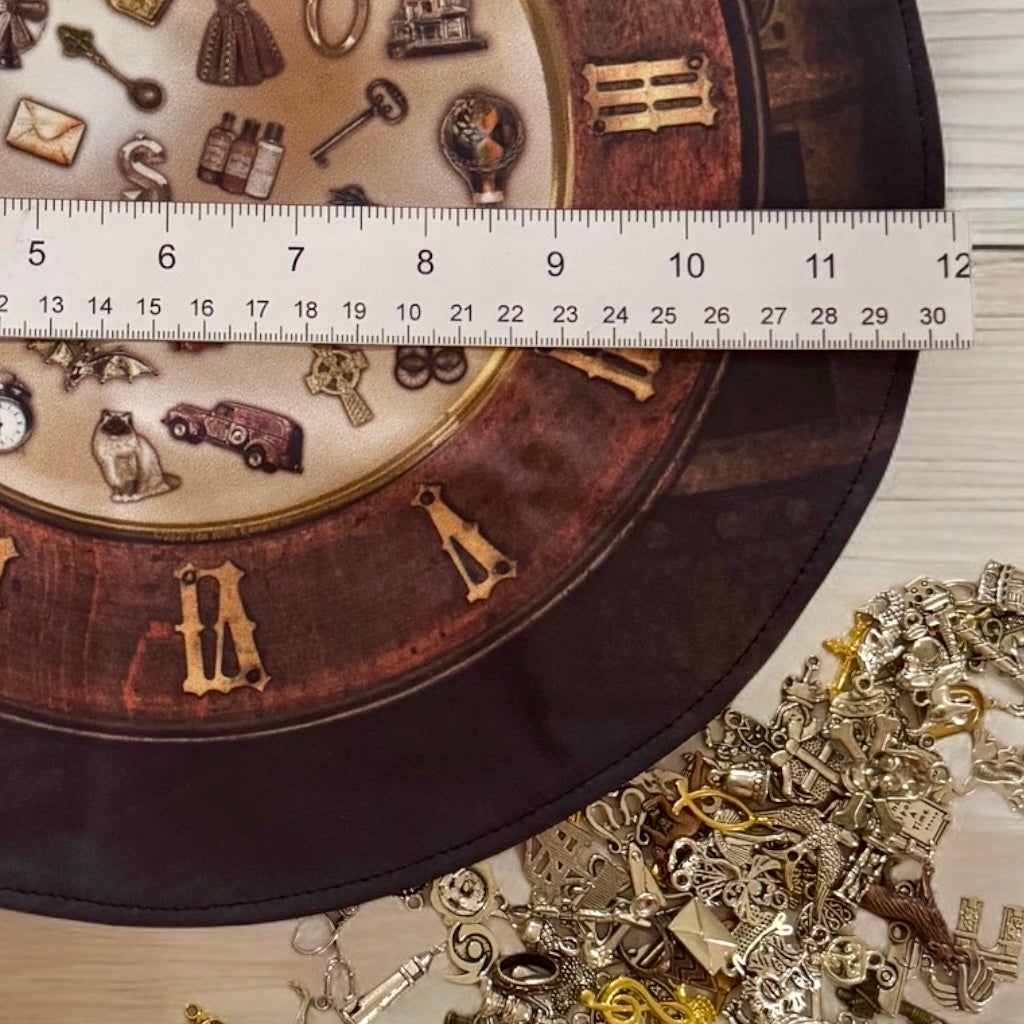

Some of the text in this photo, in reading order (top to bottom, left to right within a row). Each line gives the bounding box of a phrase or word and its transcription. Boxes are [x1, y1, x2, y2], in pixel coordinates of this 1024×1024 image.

[28, 240, 46, 267] 5
[158, 243, 176, 270] 6
[287, 246, 305, 272] 7
[416, 249, 435, 276] 8
[546, 250, 565, 278] 9
[669, 251, 705, 279] 10
[805, 252, 835, 279] 11
[936, 252, 971, 279] 12
[39, 295, 64, 314] 13
[88, 296, 113, 315] 14
[137, 297, 162, 316] 15
[190, 298, 214, 317] 16
[246, 299, 270, 318] 17
[294, 300, 318, 319] 18
[342, 301, 367, 320] 19
[396, 303, 422, 321] 10
[450, 303, 472, 322] 21
[497, 304, 524, 323] 22
[552, 305, 579, 323] 23
[602, 305, 629, 324] 24
[650, 305, 677, 325] 25
[703, 305, 731, 325] 26
[760, 306, 788, 325] 27
[810, 306, 838, 326] 28
[861, 306, 889, 326] 29
[919, 306, 947, 326] 30
